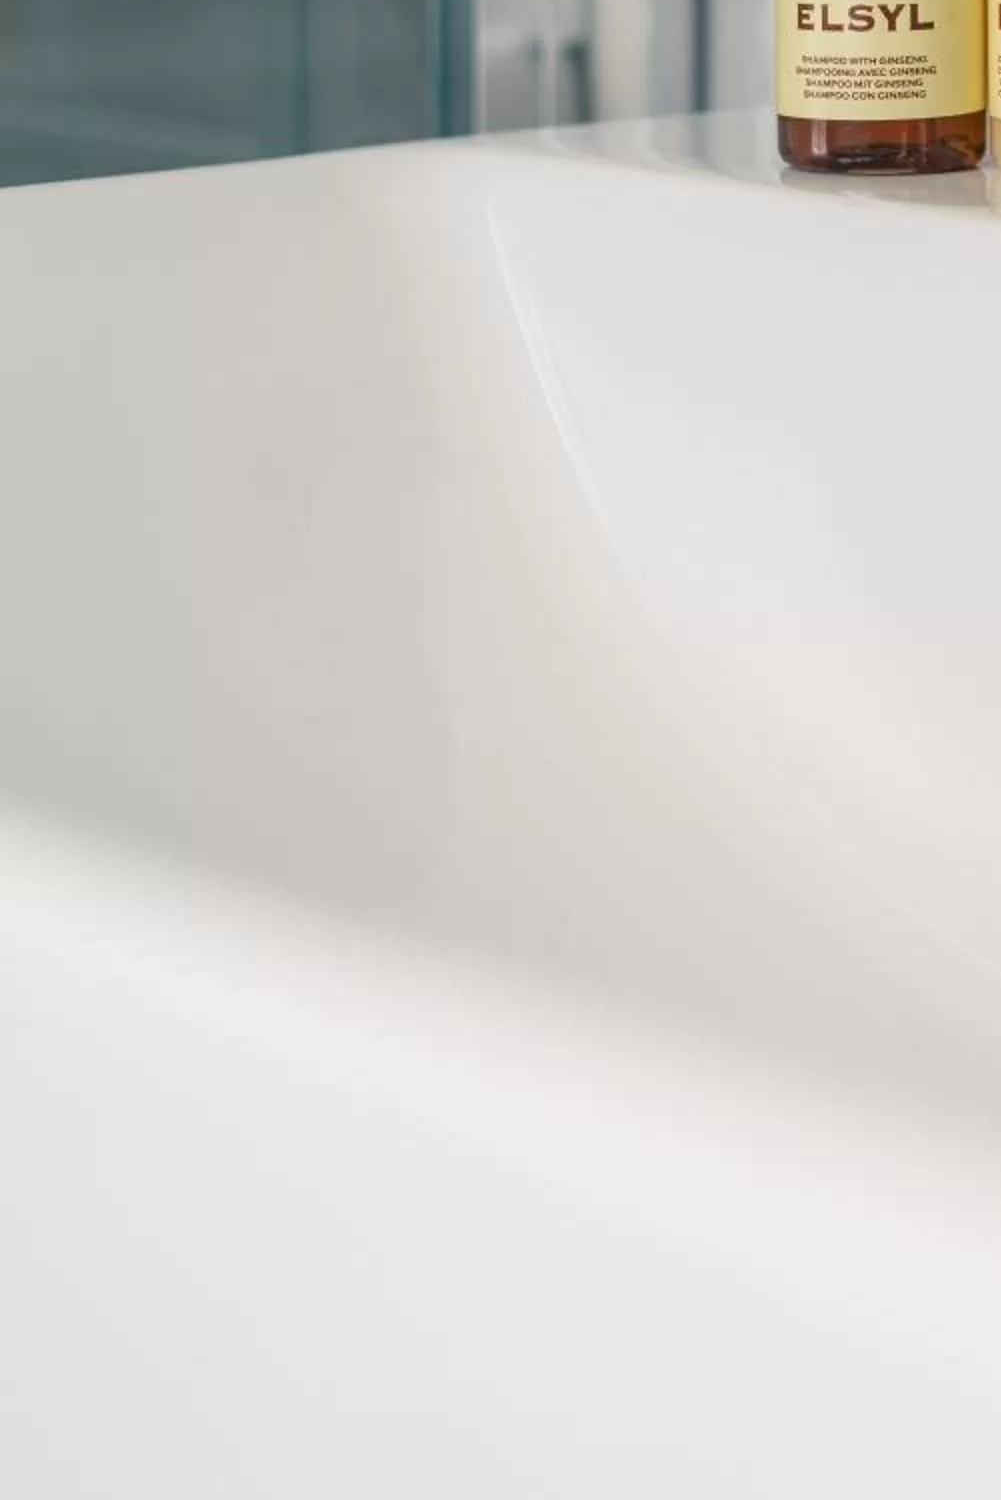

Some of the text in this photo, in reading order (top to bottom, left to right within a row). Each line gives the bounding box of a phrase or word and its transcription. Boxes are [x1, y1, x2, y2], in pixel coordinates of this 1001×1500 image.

[797, 3, 935, 32] ELSYL
[801, 55, 928, 65] SHAMPOO WITH GINSENG
[796, 65, 937, 77] SHAMPOOING AVEC GINSENG
[805, 78, 924, 88] SHAMPOO MIT GINSENG
[803, 89, 927, 100] SHAMPOO CON GINSENG
